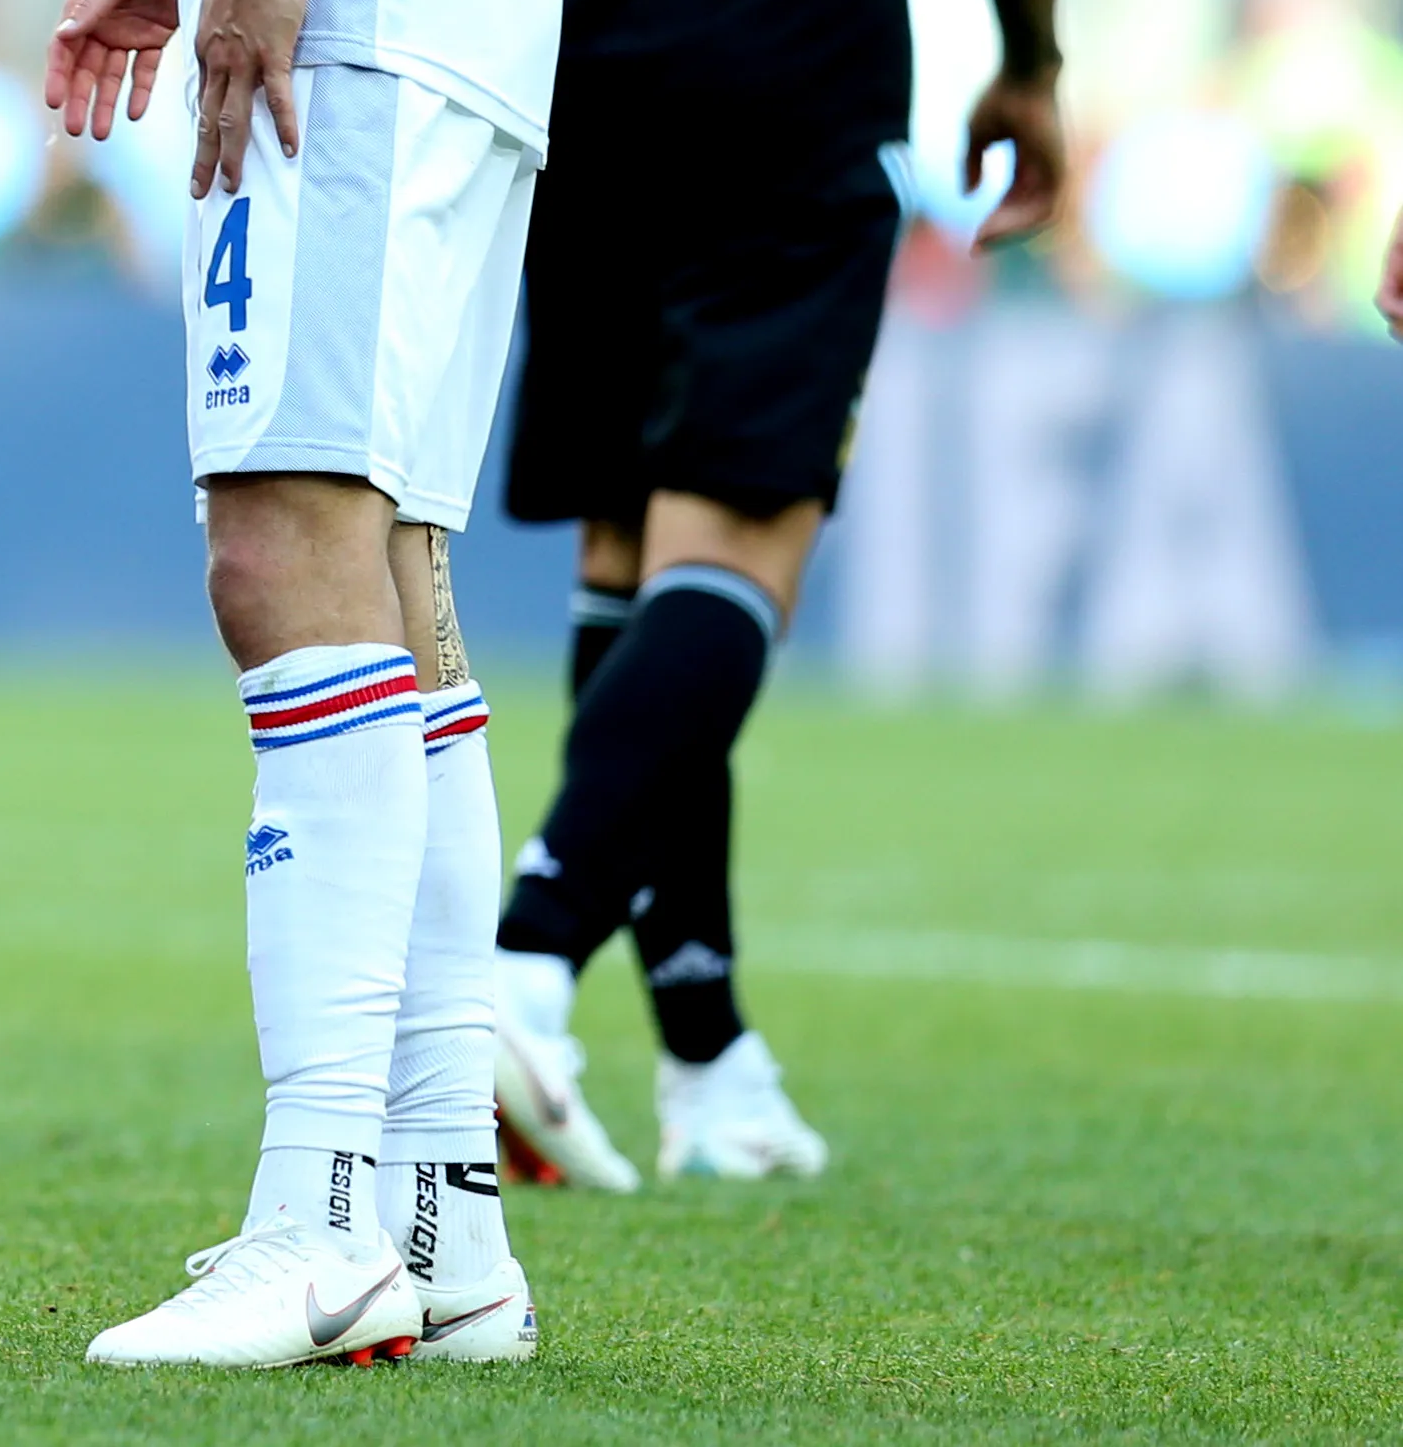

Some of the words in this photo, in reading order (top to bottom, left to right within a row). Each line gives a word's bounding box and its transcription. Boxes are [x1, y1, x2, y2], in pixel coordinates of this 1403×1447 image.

[204, 196, 253, 332] 4
[205, 384, 250, 410] errea
[833, 317, 1328, 702] IFA
